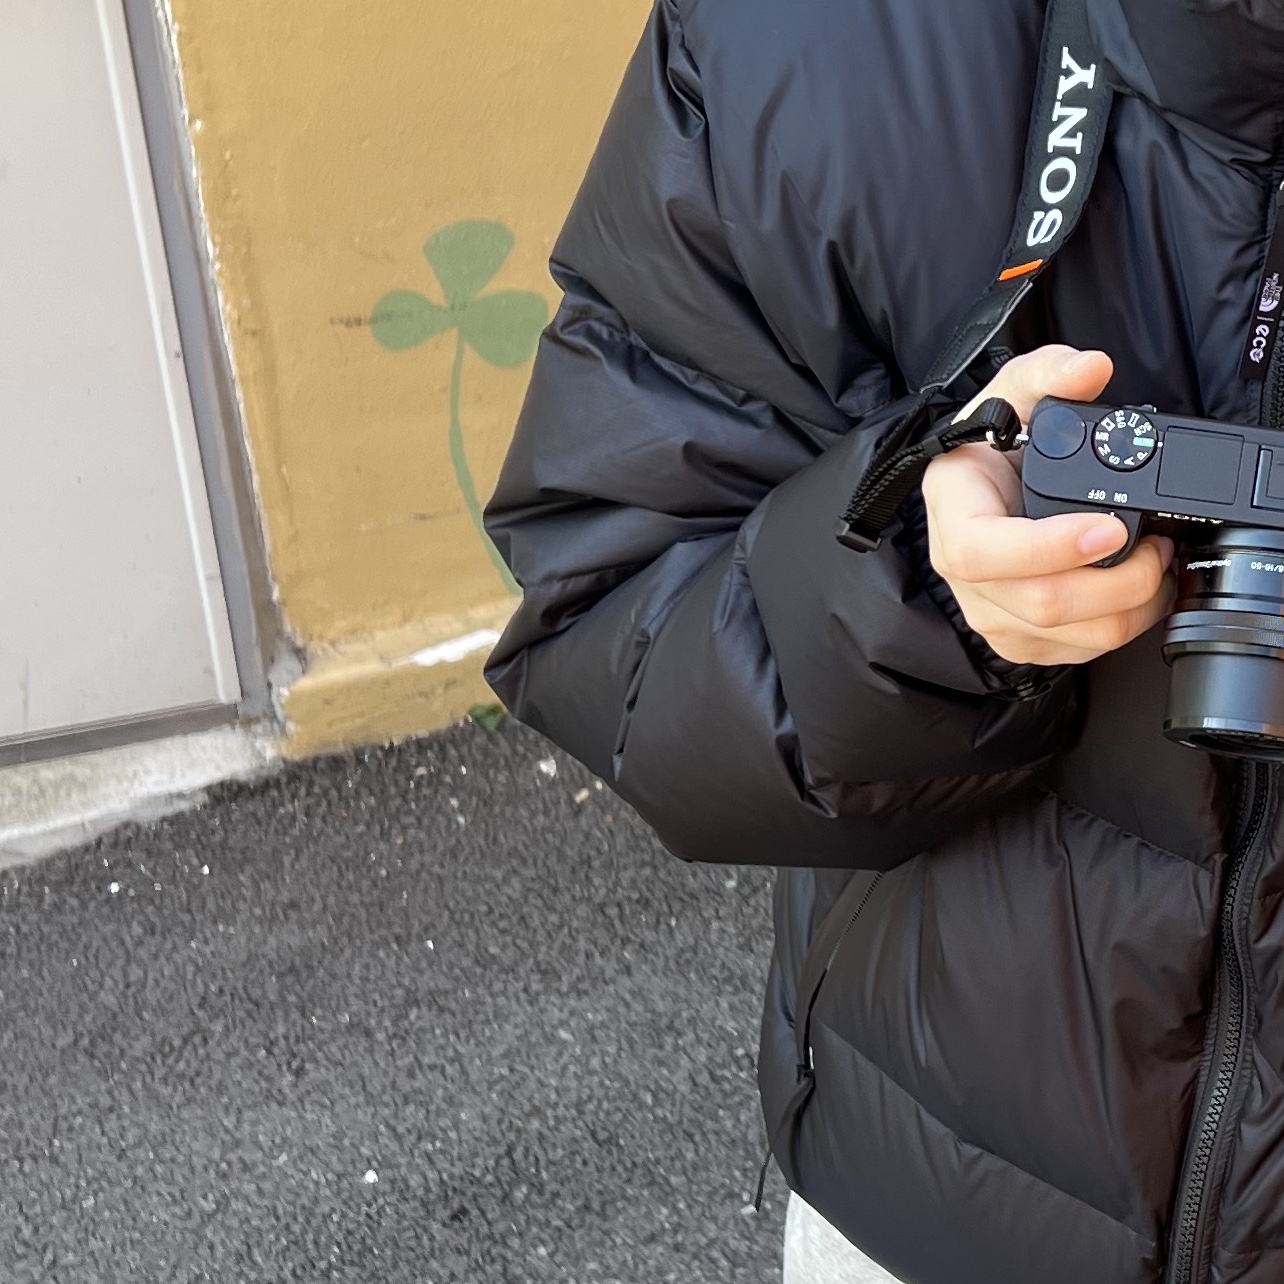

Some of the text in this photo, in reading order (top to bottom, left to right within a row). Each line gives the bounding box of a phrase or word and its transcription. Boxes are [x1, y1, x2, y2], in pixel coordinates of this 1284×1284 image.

[1026, 46, 1096, 247] SONY
[1249, 324, 1269, 364] eco
[1097, 443, 1112, 457] M
[1136, 451, 1149, 461] P
[1108, 455, 1121, 465] S
[1123, 456, 1136, 466] A
[1087, 489, 1128, 504] ON OFF
